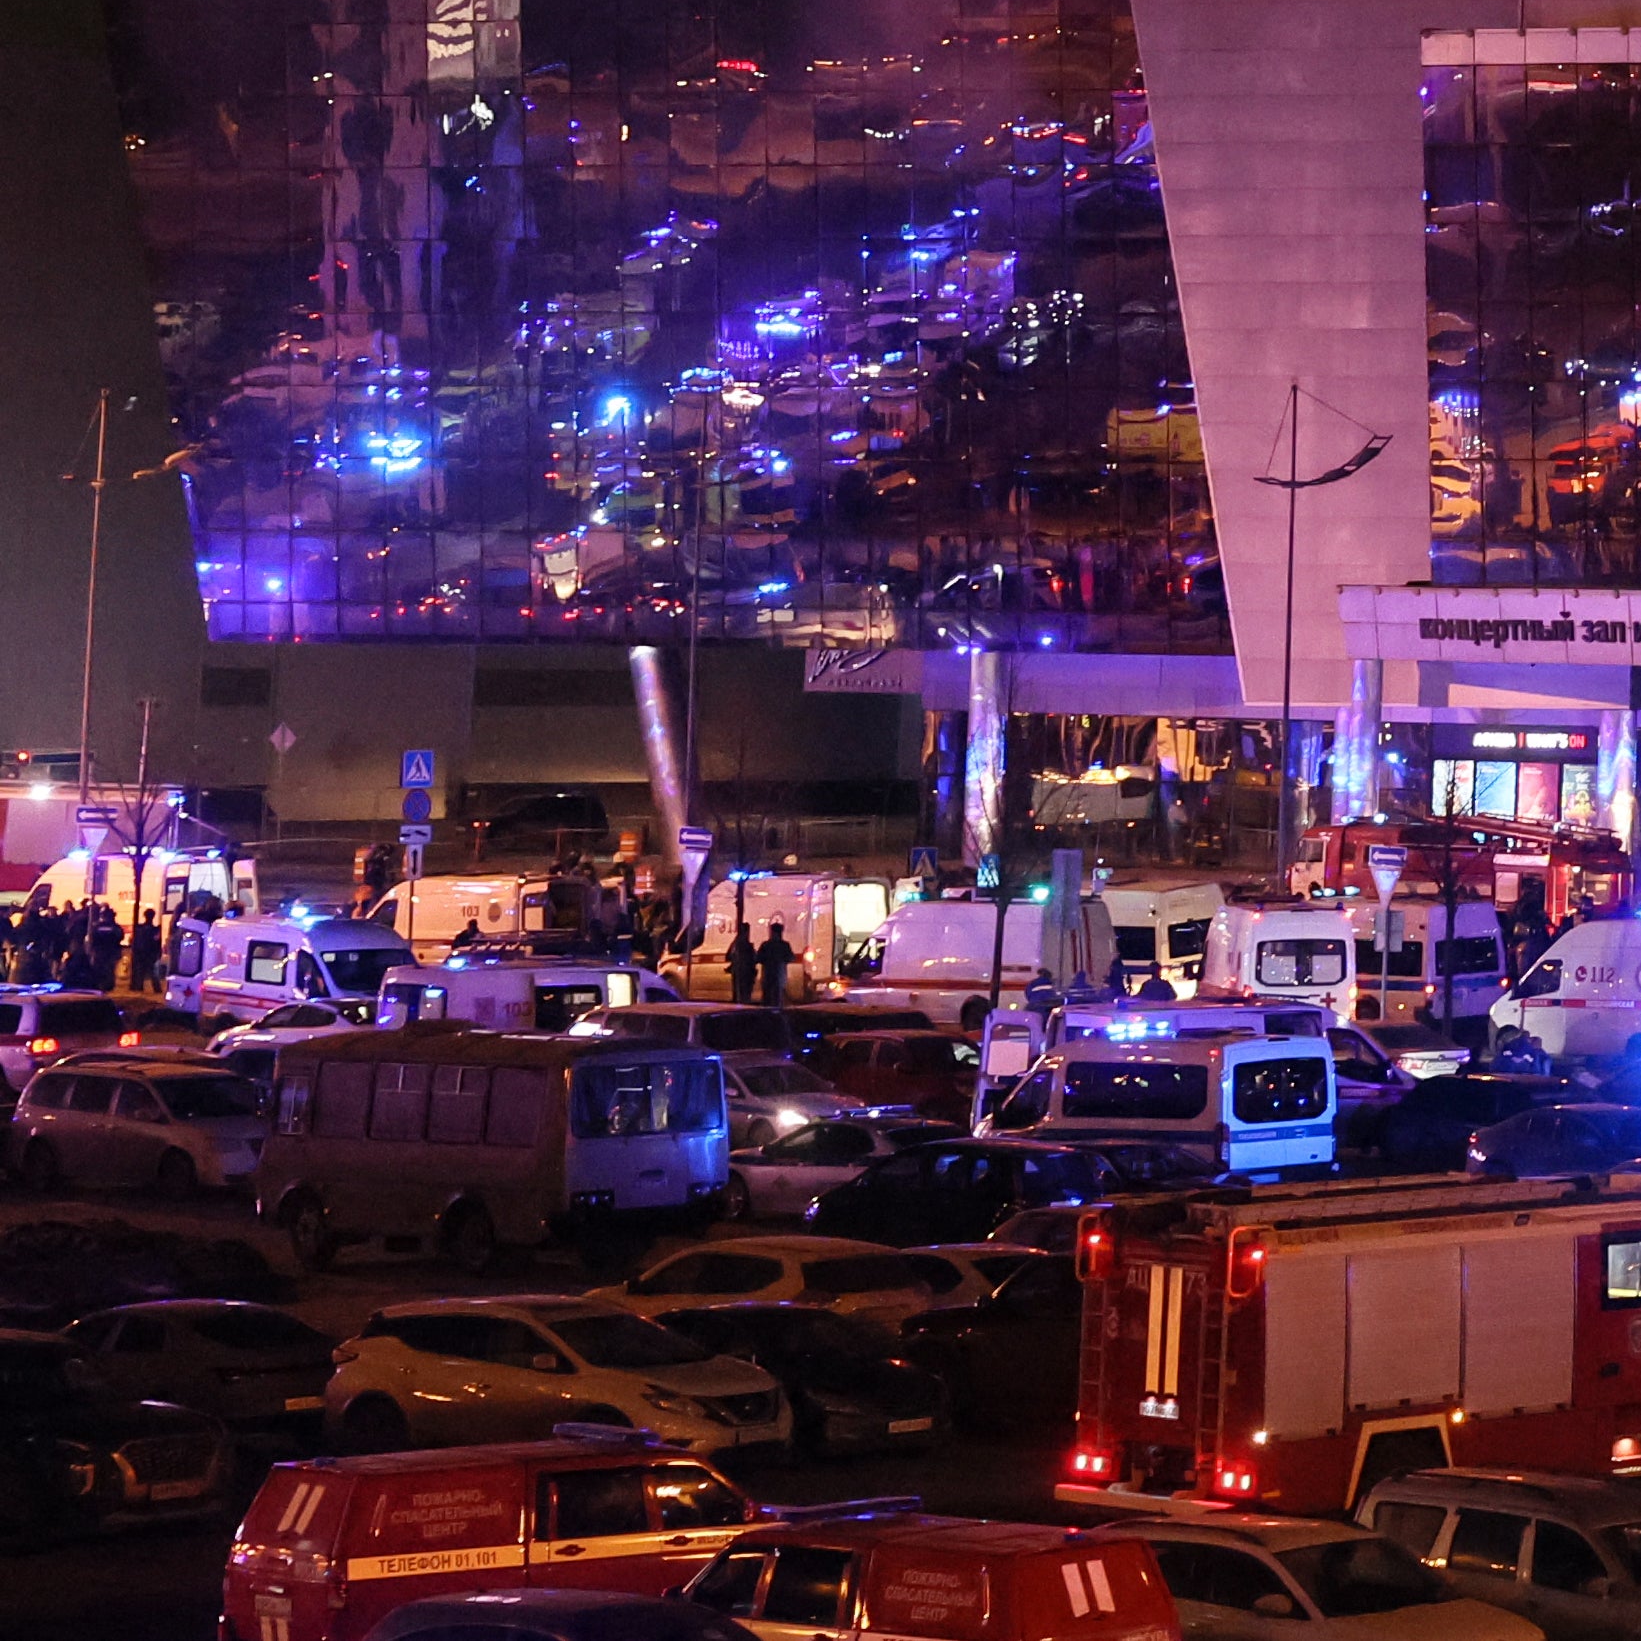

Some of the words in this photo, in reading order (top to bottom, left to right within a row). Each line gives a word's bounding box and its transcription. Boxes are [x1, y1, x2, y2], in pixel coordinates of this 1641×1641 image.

[1569, 735, 1586, 749] ON
[462, 905, 480, 917] 103
[1590, 966, 1616, 983] 112
[412, 1489, 486, 1510] ПОЖАРНО-
[390, 1501, 504, 1524] СПАСАТЕЛЬНЫЙ
[422, 1520, 469, 1539] ЦЕНТР
[378, 1554, 451, 1574] ТЕЛЕФОН
[910, 1605, 949, 1622] ЦЕНТР
